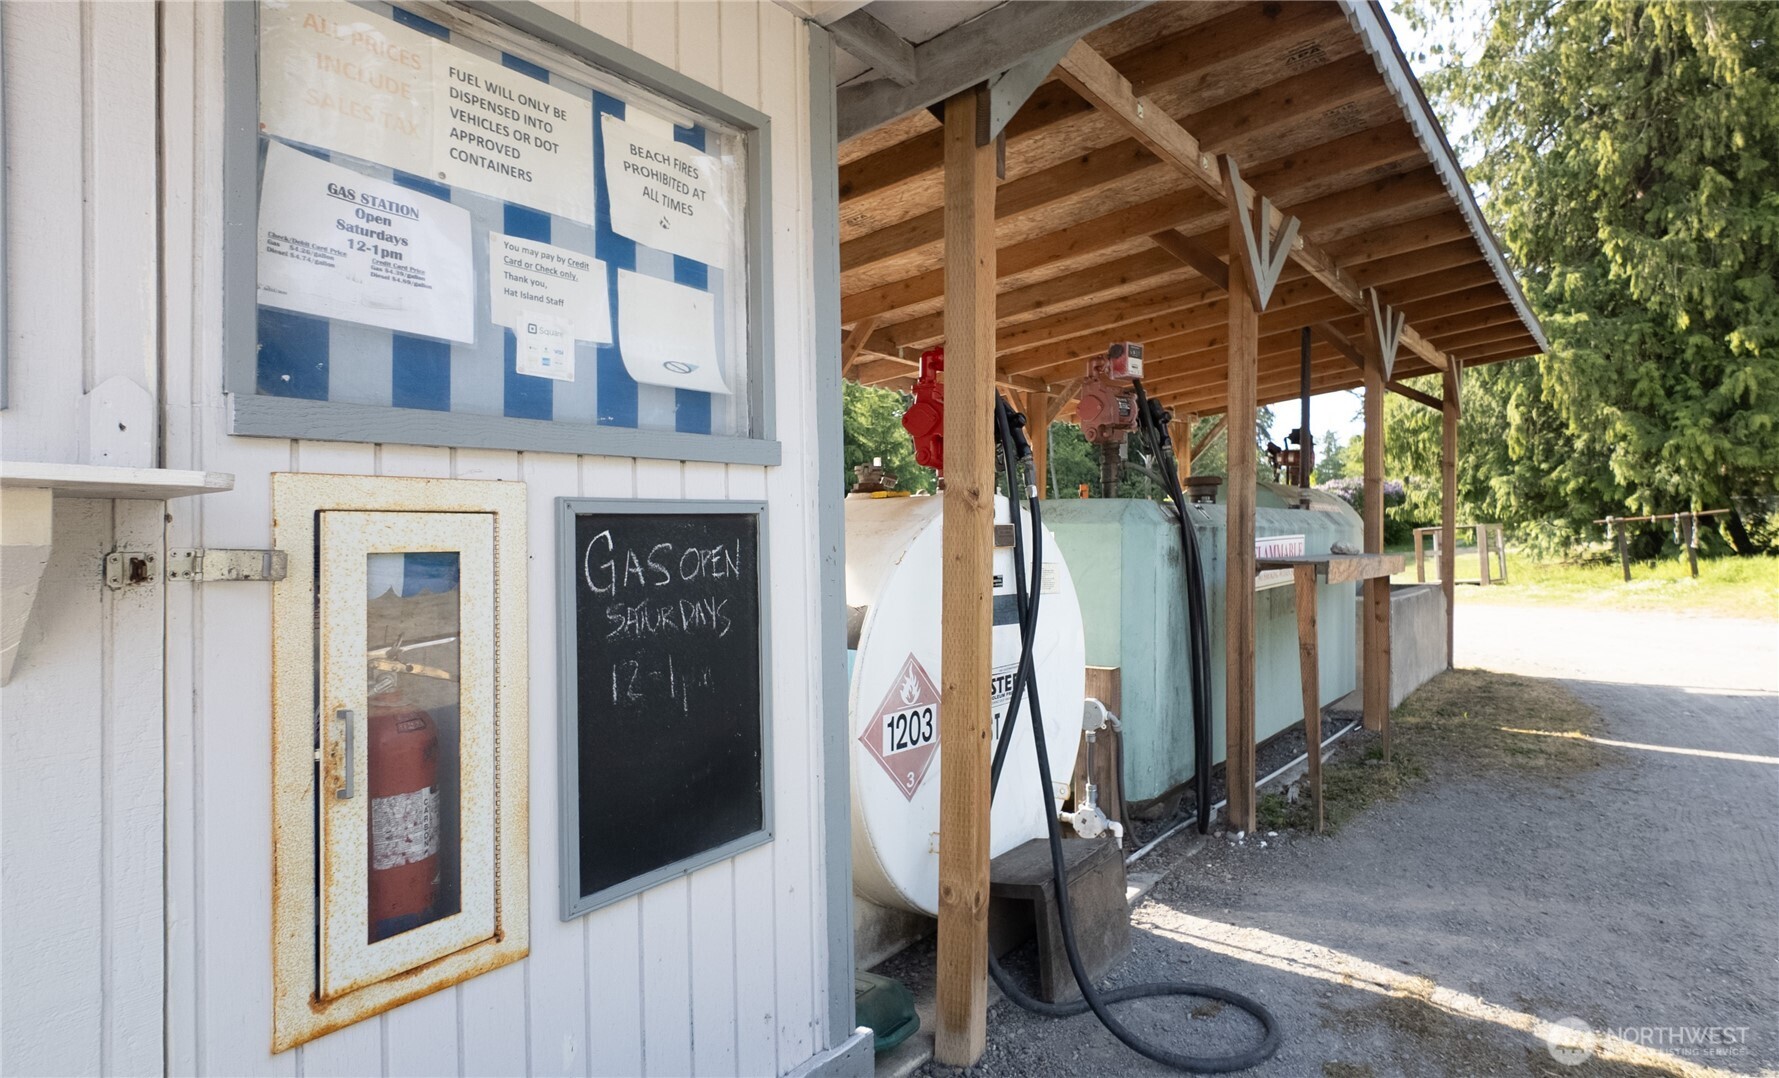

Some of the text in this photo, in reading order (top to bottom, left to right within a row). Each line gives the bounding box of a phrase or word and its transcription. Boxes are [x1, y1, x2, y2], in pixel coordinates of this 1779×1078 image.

[302, 12, 422, 71] ALL PRICES
[317, 51, 411, 100] INCLUDE
[449, 66, 568, 121] FUEL WILL ONLY BE
[305, 88, 420, 139] SALES TAX
[449, 87, 554, 134] DISPENSED INTO
[449, 107, 560, 154] VEHICLES OR DOT
[449, 127, 521, 160] APPROVED
[449, 147, 533, 183] CONTAINERS
[629, 143, 699, 180] BEACH FIRES
[624, 160, 707, 202] PROHIBITED AT
[327, 182, 420, 220] GAS STATION
[642, 185, 694, 217] ALL TIMES
[336, 218, 409, 247] Saturdays
[355, 207, 392, 227] Open
[266, 246, 288, 257] Diesel
[267, 239, 280, 247] Gas
[311, 243, 328, 252] Card
[330, 248, 347, 257] Price
[347, 238, 403, 261] 12-1pm
[503, 241, 590, 272] You may pay by Credit
[370, 264, 383, 272] Gas
[370, 271, 390, 281] Diesel
[372, 258, 391, 267] Credit
[393, 262, 408, 271] Card
[503, 255, 522, 269] Card
[524, 261, 533, 272] or
[535, 263, 558, 278] Check
[504, 271, 548, 291] Thank you,
[504, 287, 565, 308] Hat Island Staff
[585, 530, 740, 596] GAS OPEN
[887, 708, 933, 752] 1203
[906, 771, 915, 789] 3
